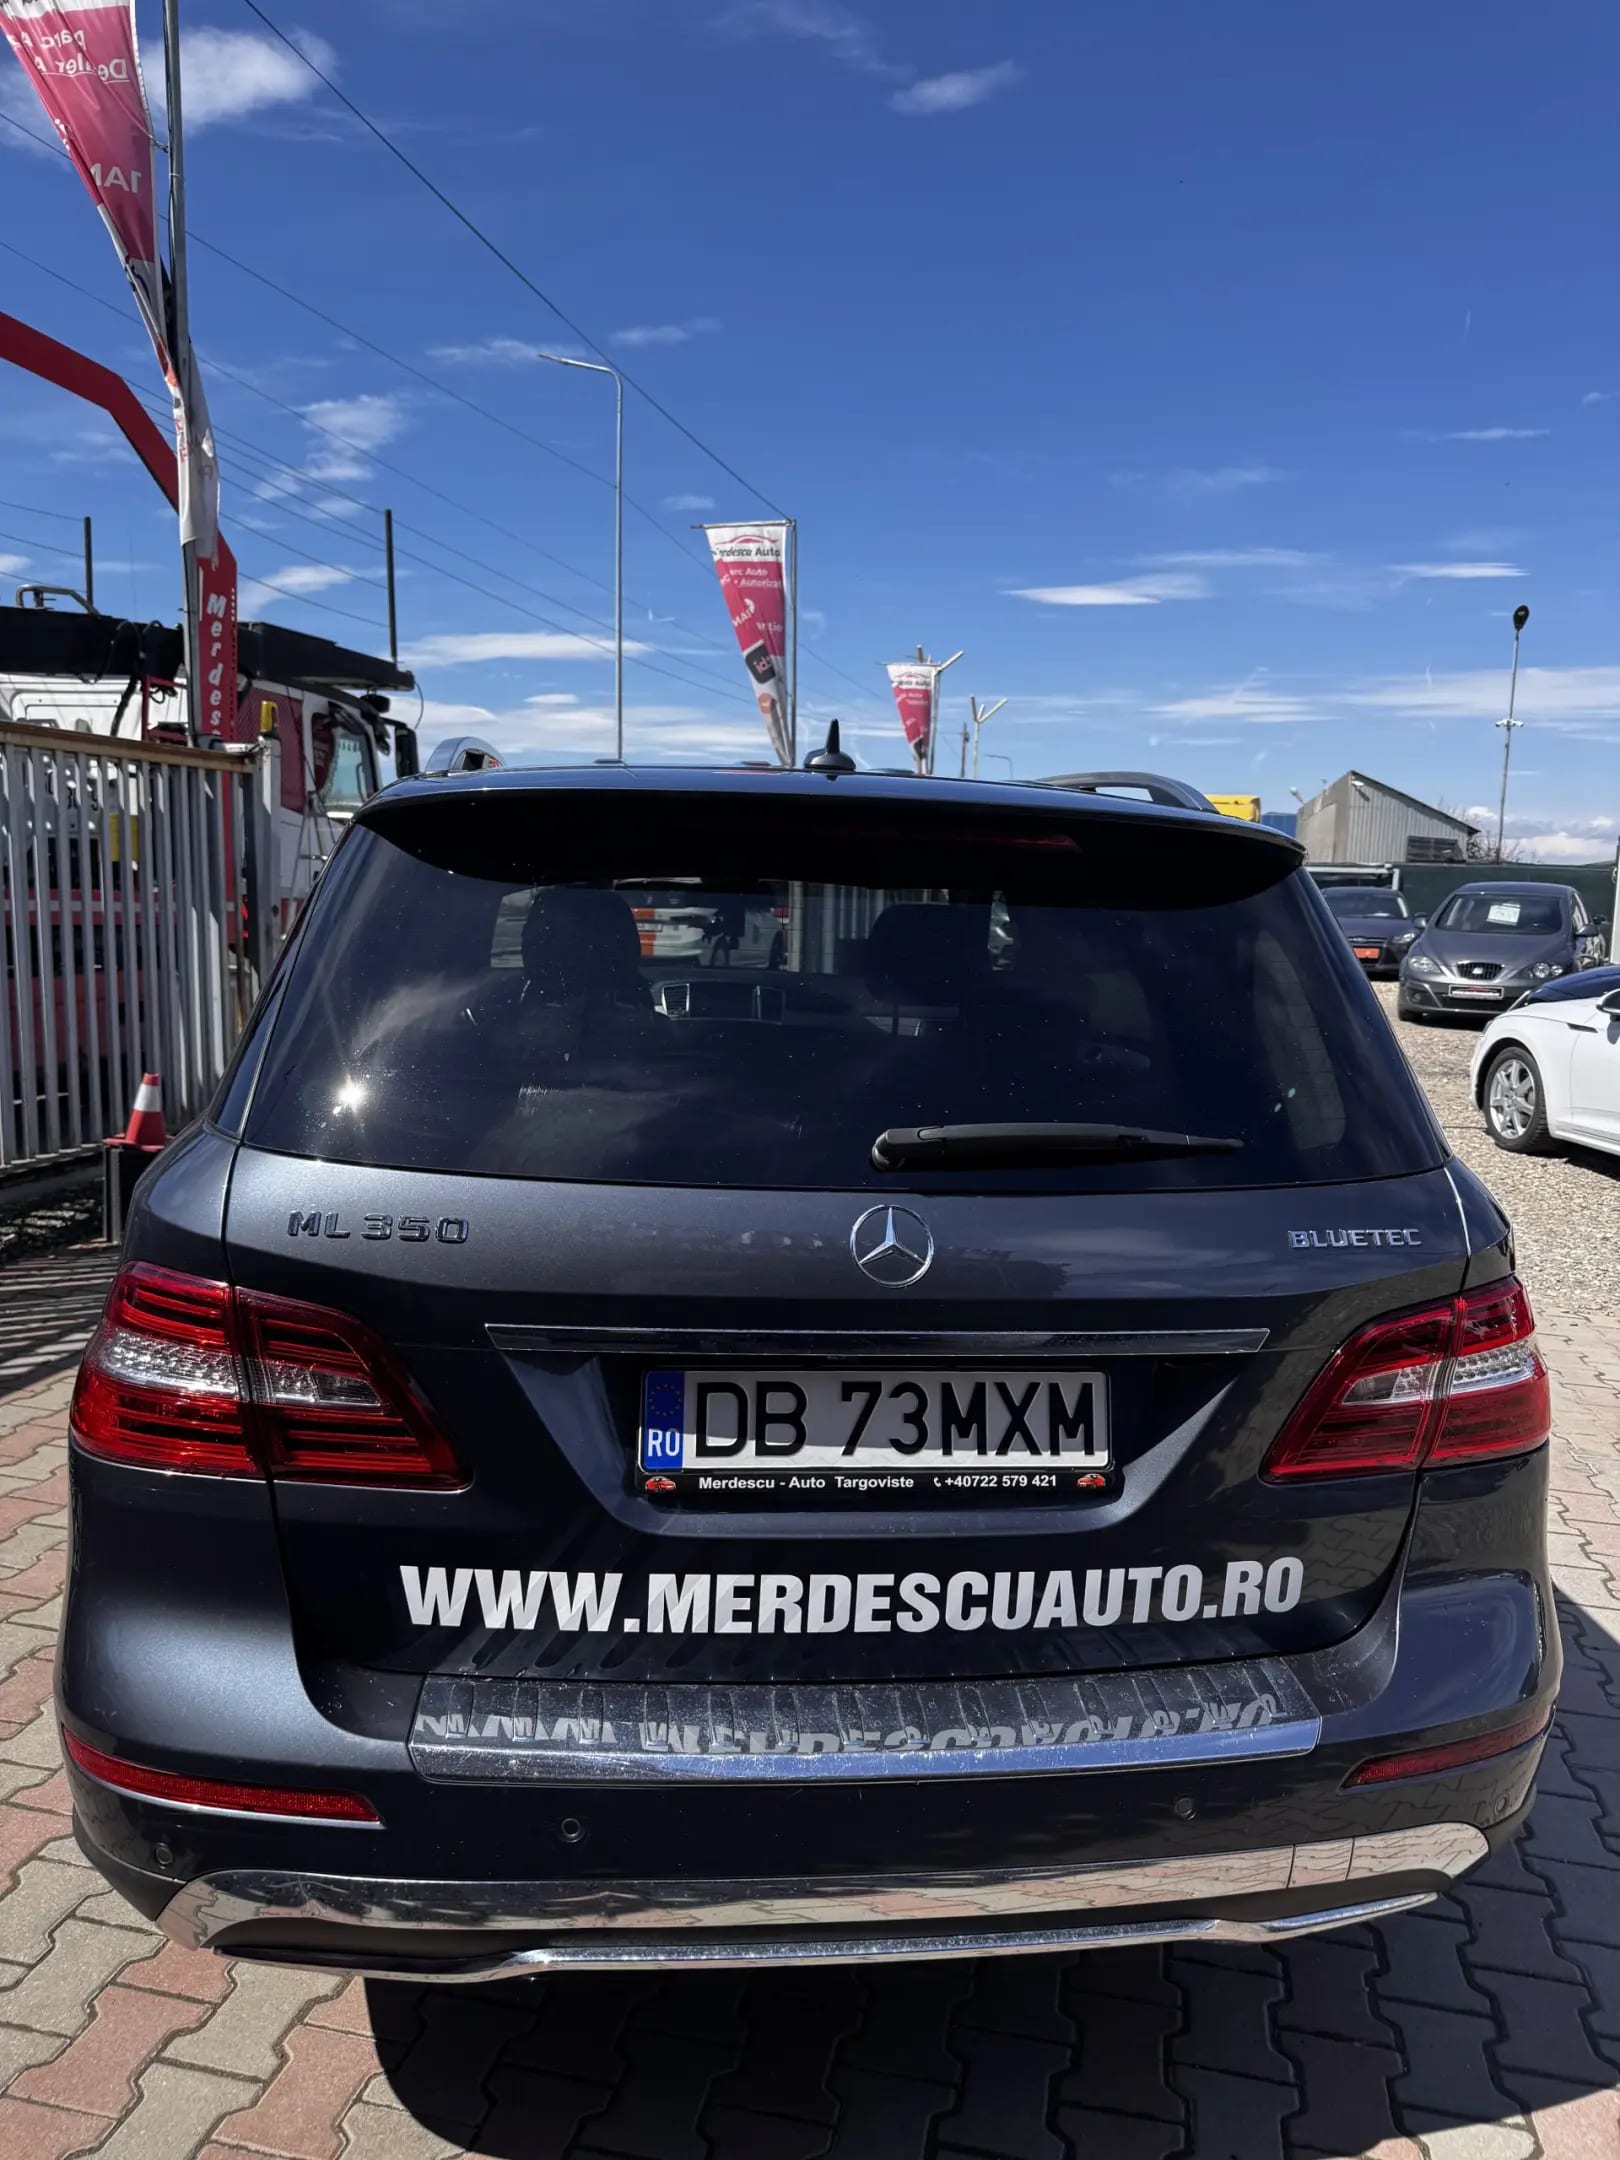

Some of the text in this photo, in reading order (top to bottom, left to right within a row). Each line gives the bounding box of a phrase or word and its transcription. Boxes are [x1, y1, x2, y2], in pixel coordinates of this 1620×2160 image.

[287, 1210, 470, 1244] ML 350
[1287, 1228, 1423, 1249] BLUETEC
[695, 1380, 808, 1458] DB
[647, 1428, 681, 1457] RO
[699, 1476, 775, 1490] Merdescu
[788, 1476, 826, 1489] Auto
[836, 1476, 914, 1491] Targoviste
[944, 1475, 998, 1489] +40722
[1001, 1475, 1029, 1488] 579
[1032, 1475, 1058, 1488] 421
[399, 1555, 1305, 1636] WWW.MERDESCUAUTO.RO
